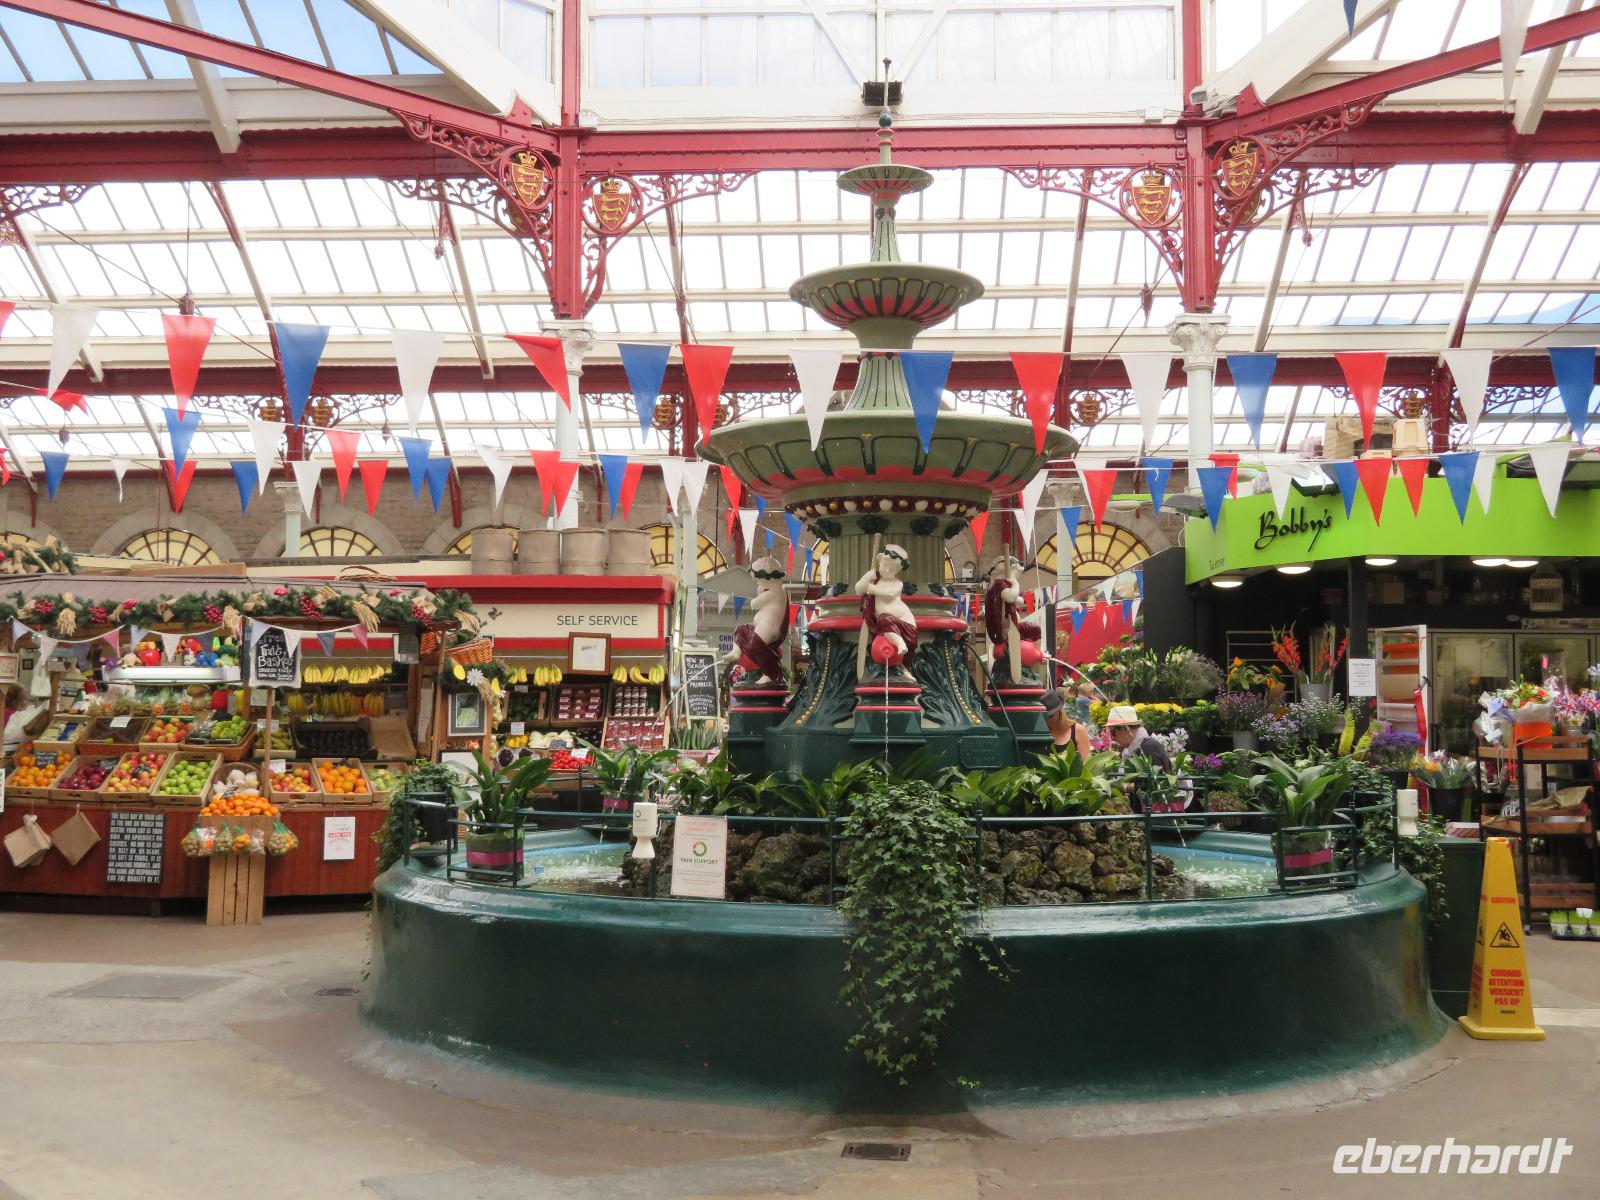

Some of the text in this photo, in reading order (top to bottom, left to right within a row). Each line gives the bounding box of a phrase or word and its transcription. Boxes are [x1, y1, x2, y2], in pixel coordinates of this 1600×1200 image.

[1254, 506, 1332, 552] Bobby's
[557, 615, 638, 626] SELF SERVICE
[1490, 969, 1522, 977] CUIDADO
[1488, 978, 1525, 987] ATTENTION
[1489, 988, 1524, 997] VORSICHT
[1494, 997, 1520, 1006] PAS OP
